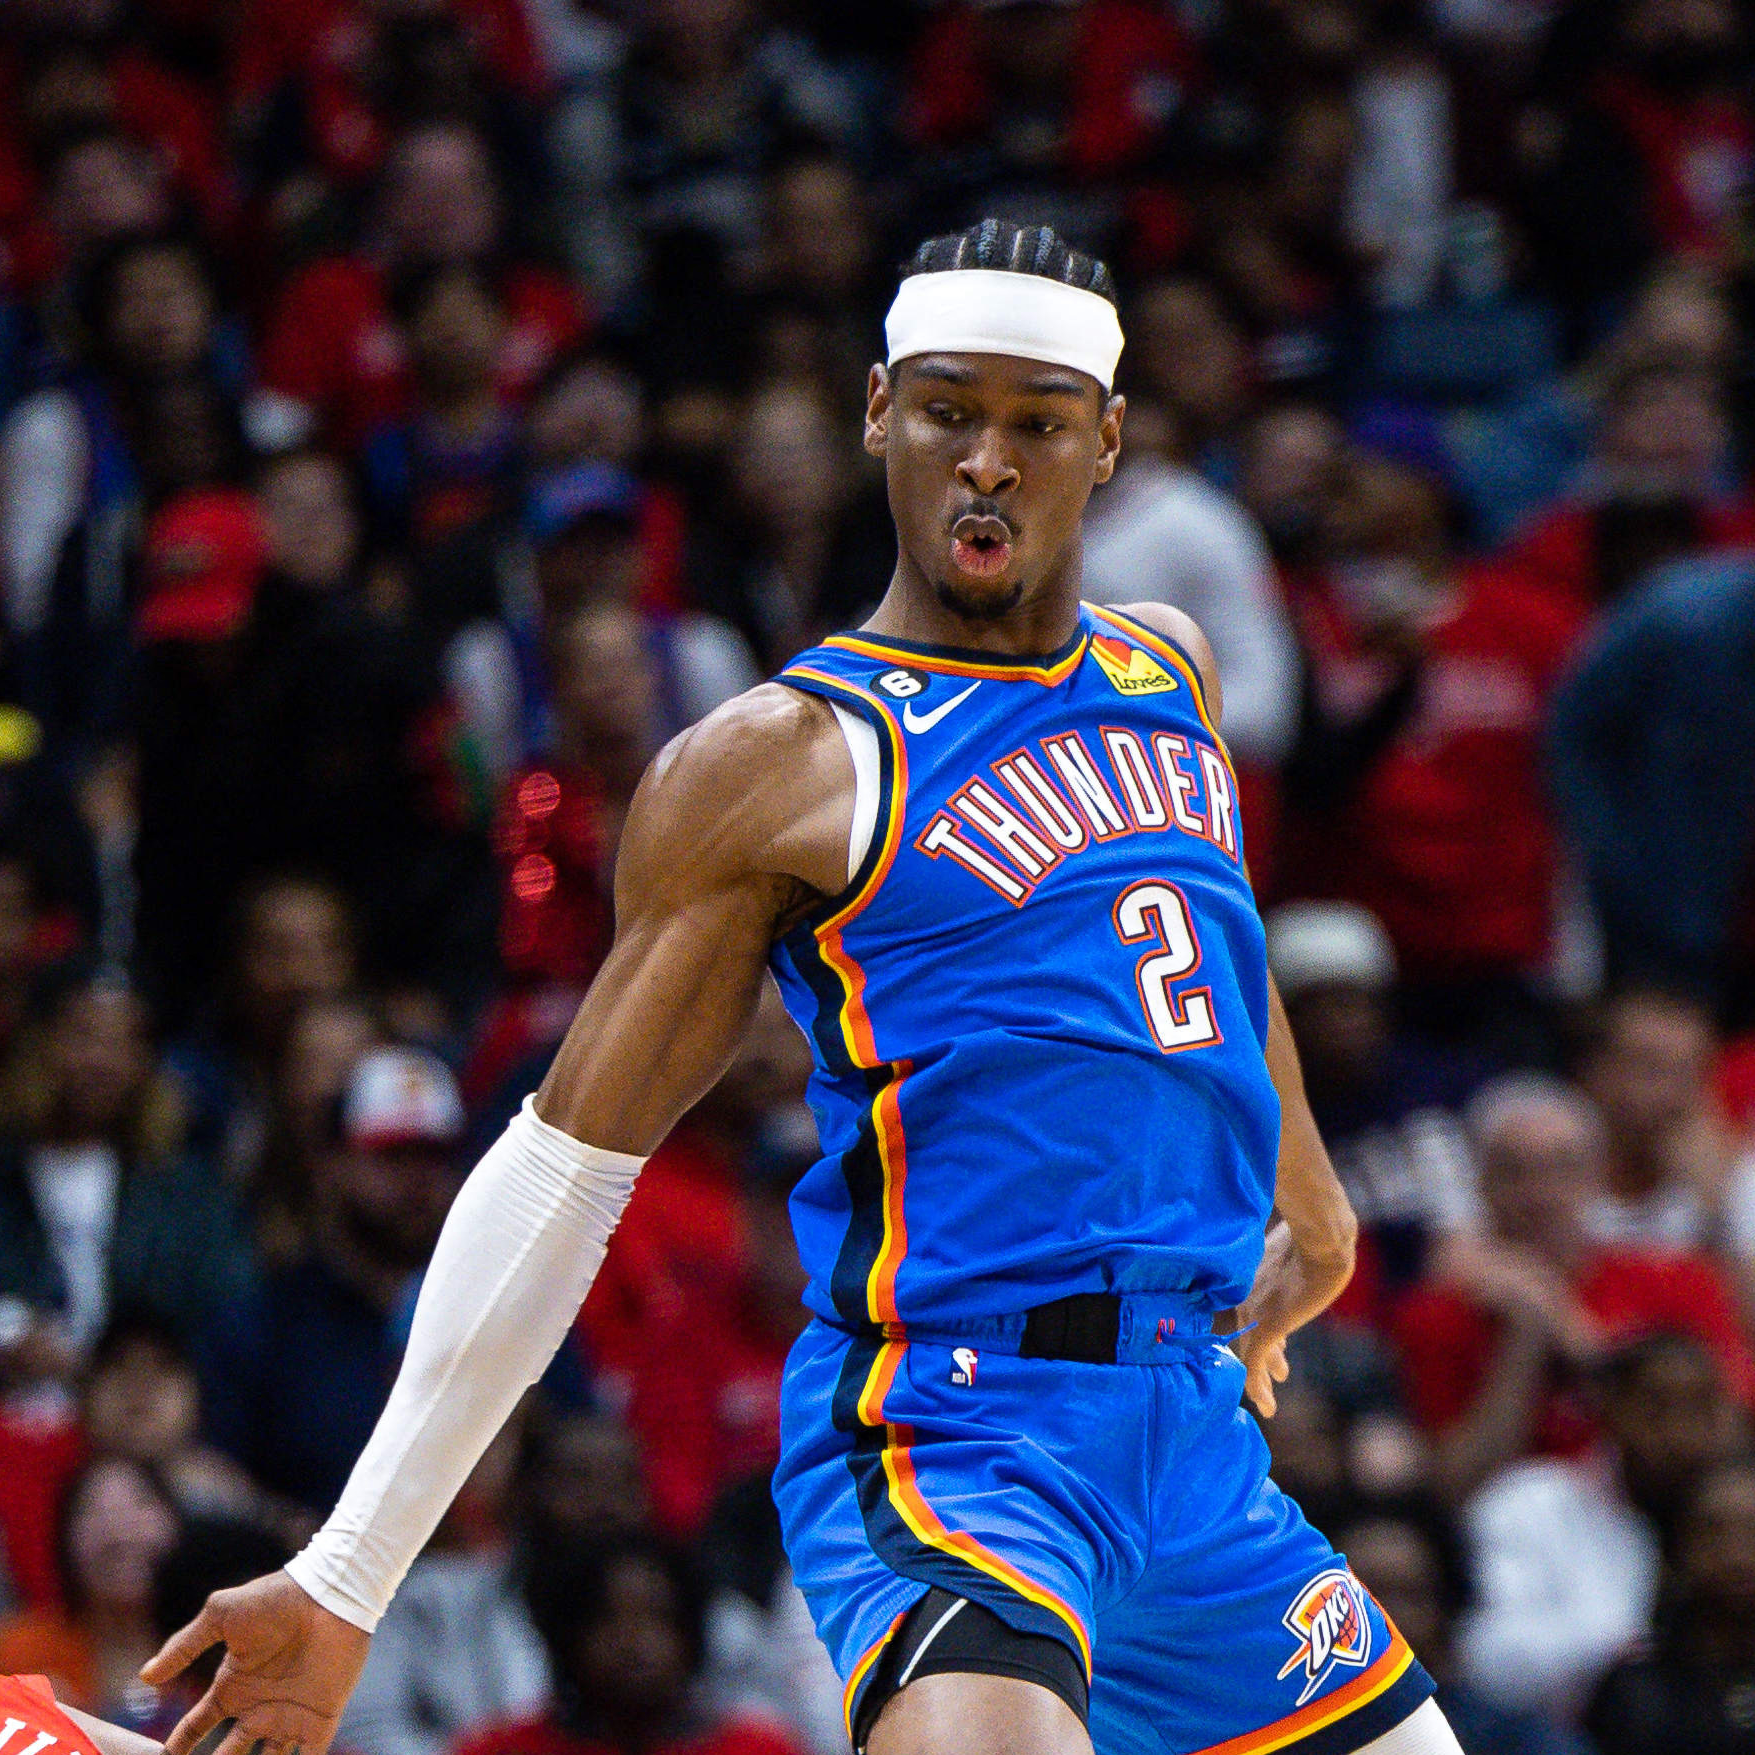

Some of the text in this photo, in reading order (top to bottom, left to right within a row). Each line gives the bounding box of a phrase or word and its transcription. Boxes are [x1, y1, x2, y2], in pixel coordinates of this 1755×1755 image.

[878, 669, 923, 698] 6
[914, 725, 1239, 908] THUNDER
[1112, 878, 1224, 1055] 2
